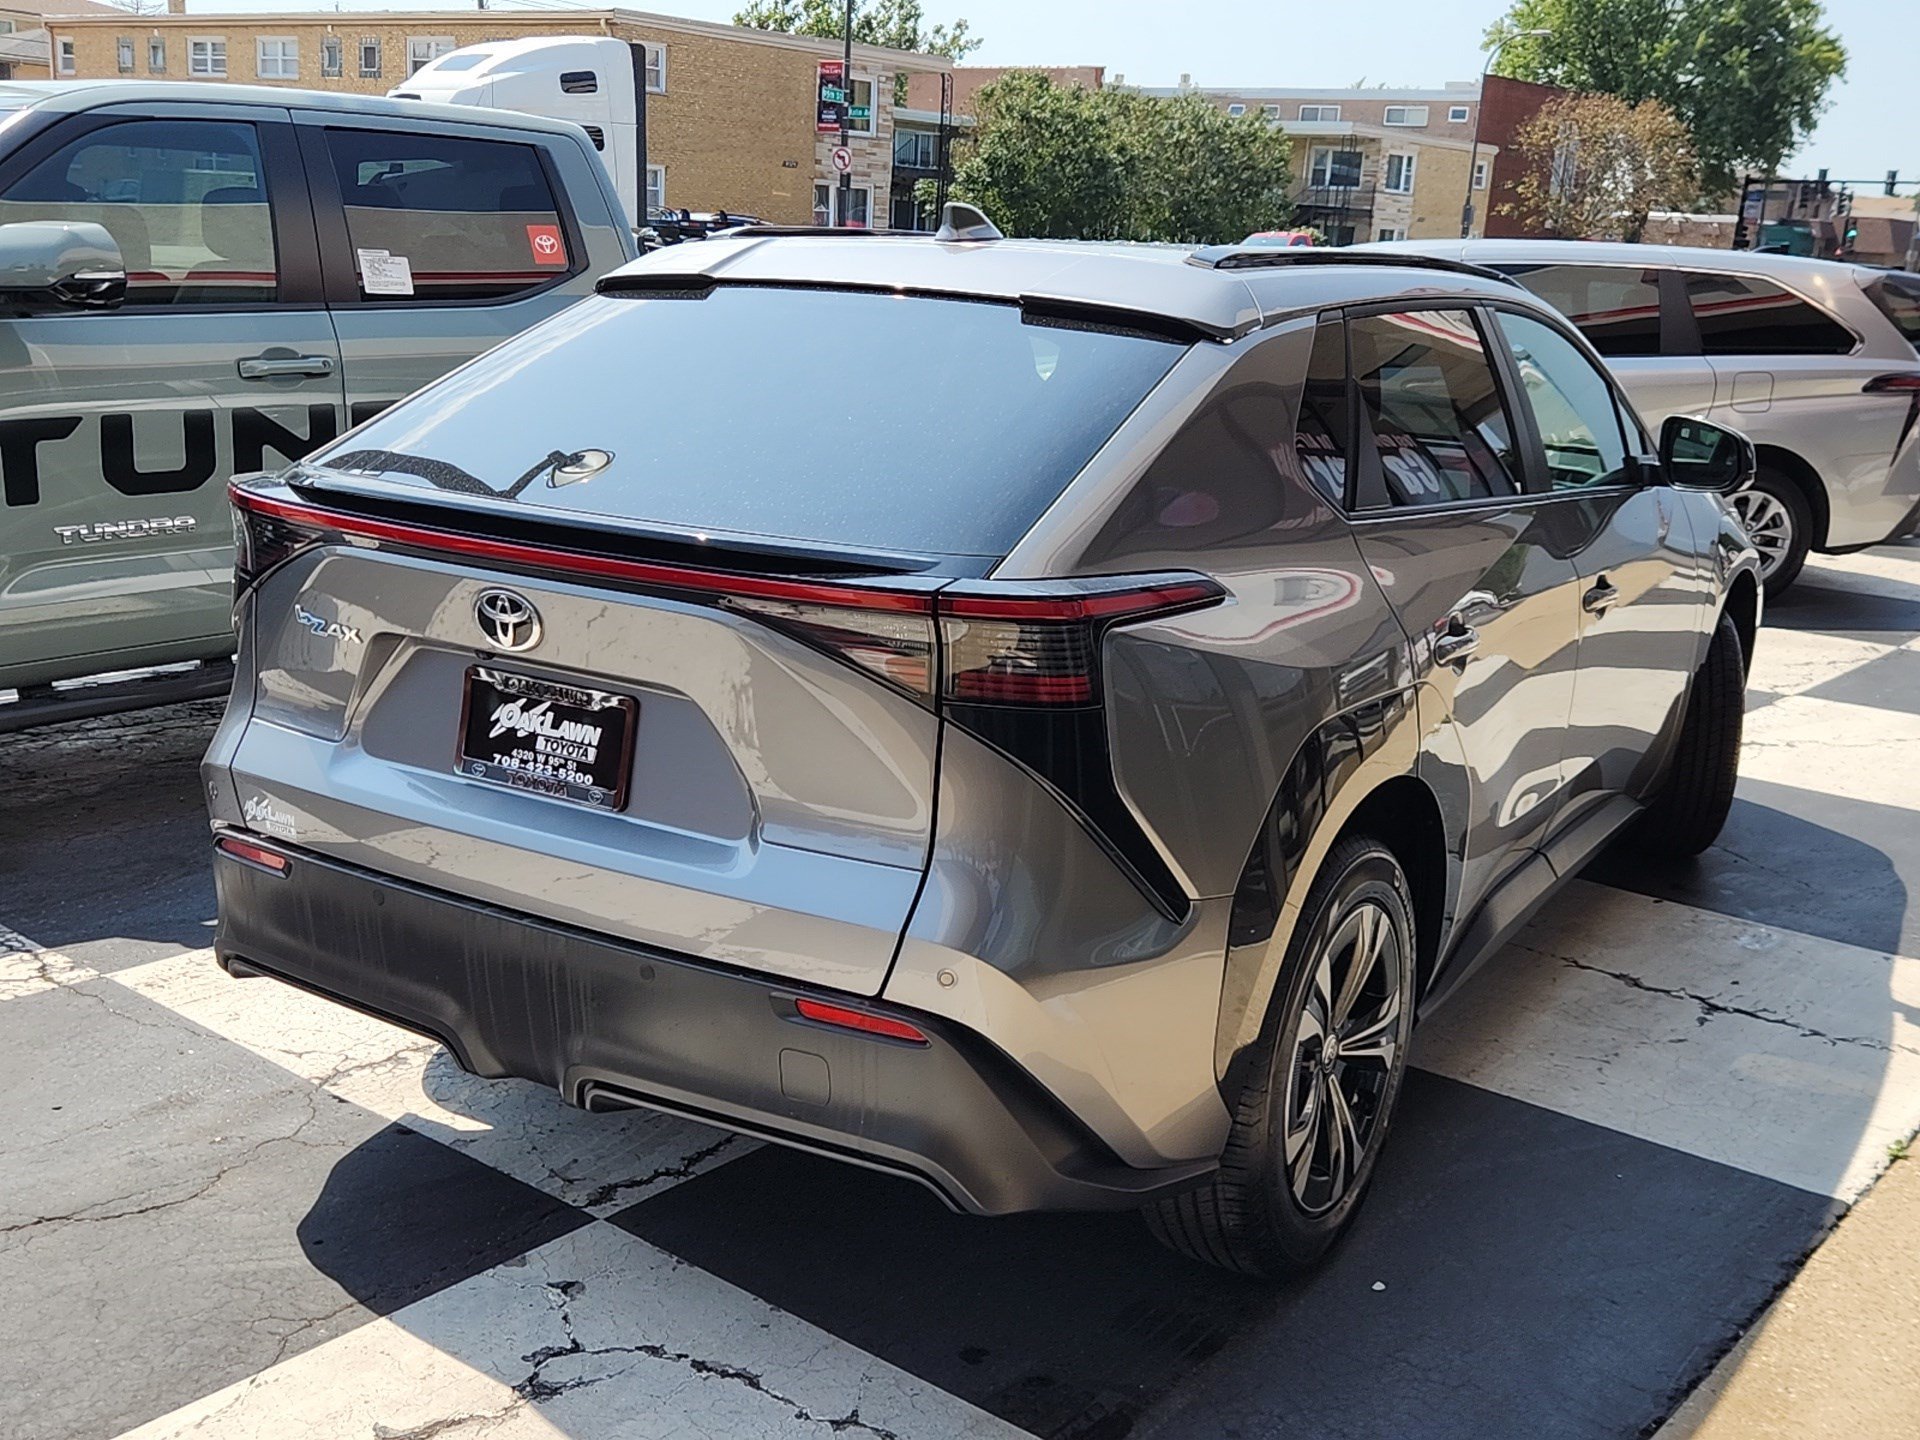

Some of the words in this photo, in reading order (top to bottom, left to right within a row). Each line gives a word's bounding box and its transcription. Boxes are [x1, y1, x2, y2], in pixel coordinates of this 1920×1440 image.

[53, 515, 197, 545] TUNDRA
[511, 748, 534, 761] 4320
[536, 753, 546, 764] W
[567, 760, 577, 771] St
[543, 738, 589, 760] TOYOTA
[493, 753, 593, 785] 708-423-5200
[506, 770, 568, 795] TOYOTA
